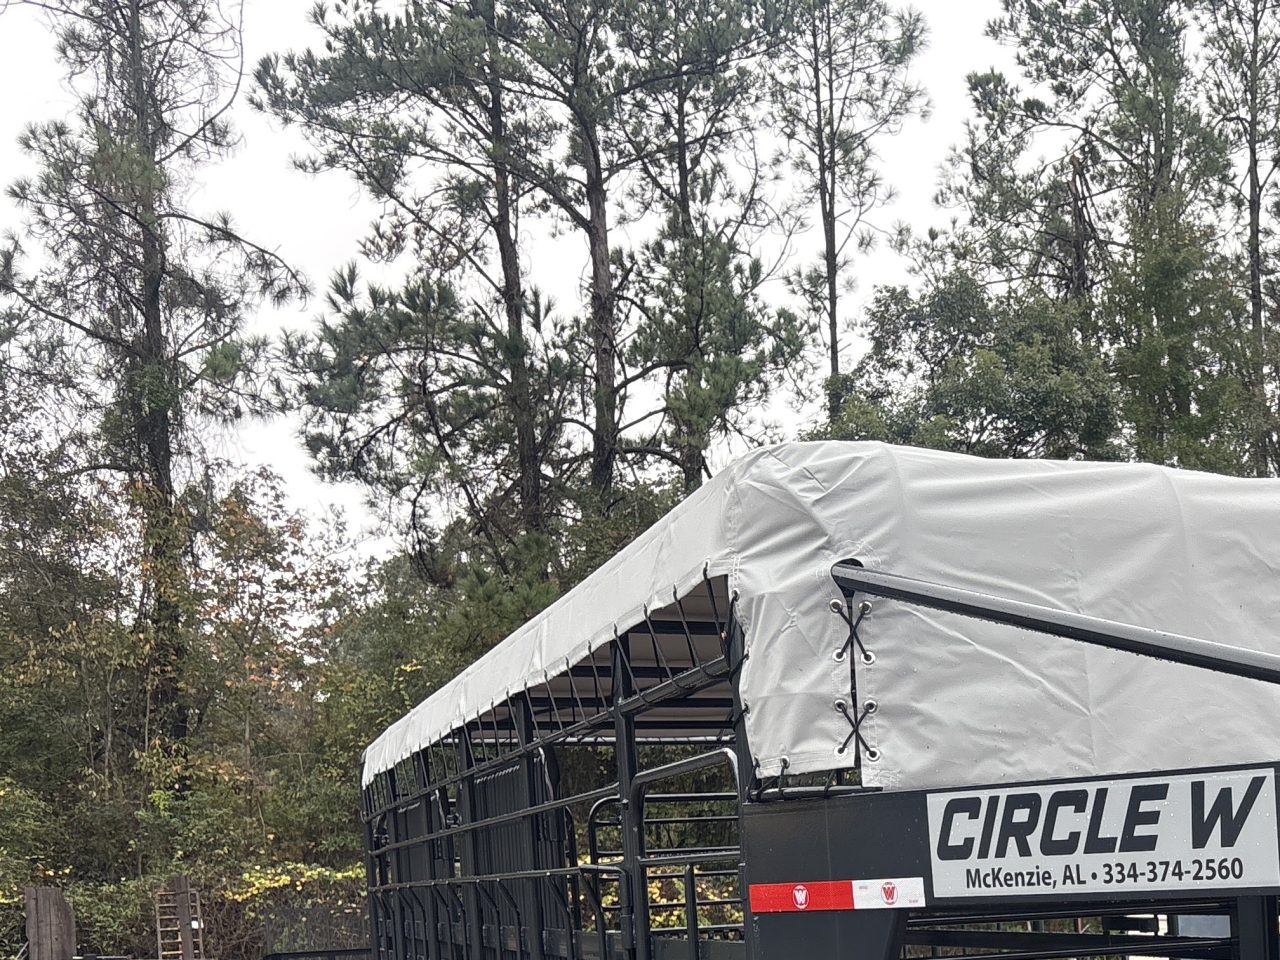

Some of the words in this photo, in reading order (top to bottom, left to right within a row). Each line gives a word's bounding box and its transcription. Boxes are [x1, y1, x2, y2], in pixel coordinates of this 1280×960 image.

[937, 783, 1170, 861] CIRCLE
[1191, 775, 1267, 850] W
[966, 864, 1056, 889] McKenzie,
[1062, 864, 1086, 885] AL
[1103, 857, 1244, 884] 334-374-2560
